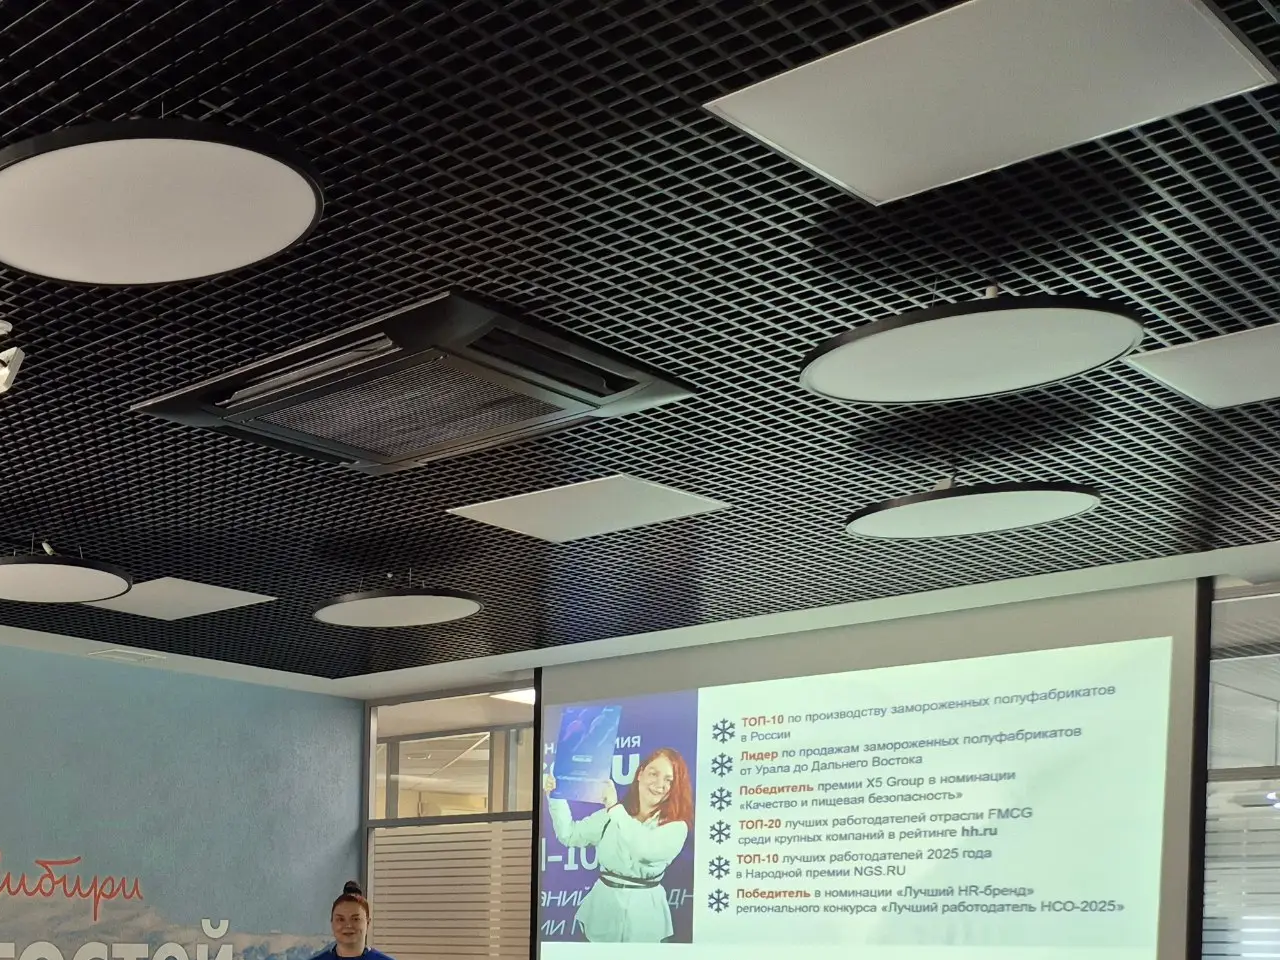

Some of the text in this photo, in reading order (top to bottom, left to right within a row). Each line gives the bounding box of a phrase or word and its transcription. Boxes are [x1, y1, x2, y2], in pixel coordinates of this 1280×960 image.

[741, 685, 1116, 727] ТОП-10 по производству замороженных полуфабрикатов
[740, 727, 1082, 762] Лидер по продажам замороженных полуфабрикатов
[751, 731, 791, 741] России
[740, 755, 923, 776] от Урала до Дальнего Востока
[740, 771, 1016, 795] Победитель премии X5 Group в номинации
[740, 800, 797, 811] «Качество
[811, 795, 865, 807] пищевая
[868, 790, 963, 804] безопасность»
[738, 807, 1033, 830] ТОП-20 лучших работодателей отрасли FMCG
[738, 835, 771, 846] среди
[775, 834, 822, 844] крупных
[825, 830, 885, 841] компаний
[899, 828, 957, 840] рейтинге
[961, 826, 998, 837] hh.ru
[737, 848, 992, 865] ТОП-10 лучших работодателей 2025 года
[736, 865, 906, 880] в Народной премии NGS.RU
[736, 888, 810, 899] Победитель
[825, 888, 892, 898] номинации
[896, 886, 954, 898] «Лучший
[958, 885, 1034, 898] HR-бренд»
[736, 900, 1124, 915] регионального конкурса «Лучший работодатель НСО-2025»
